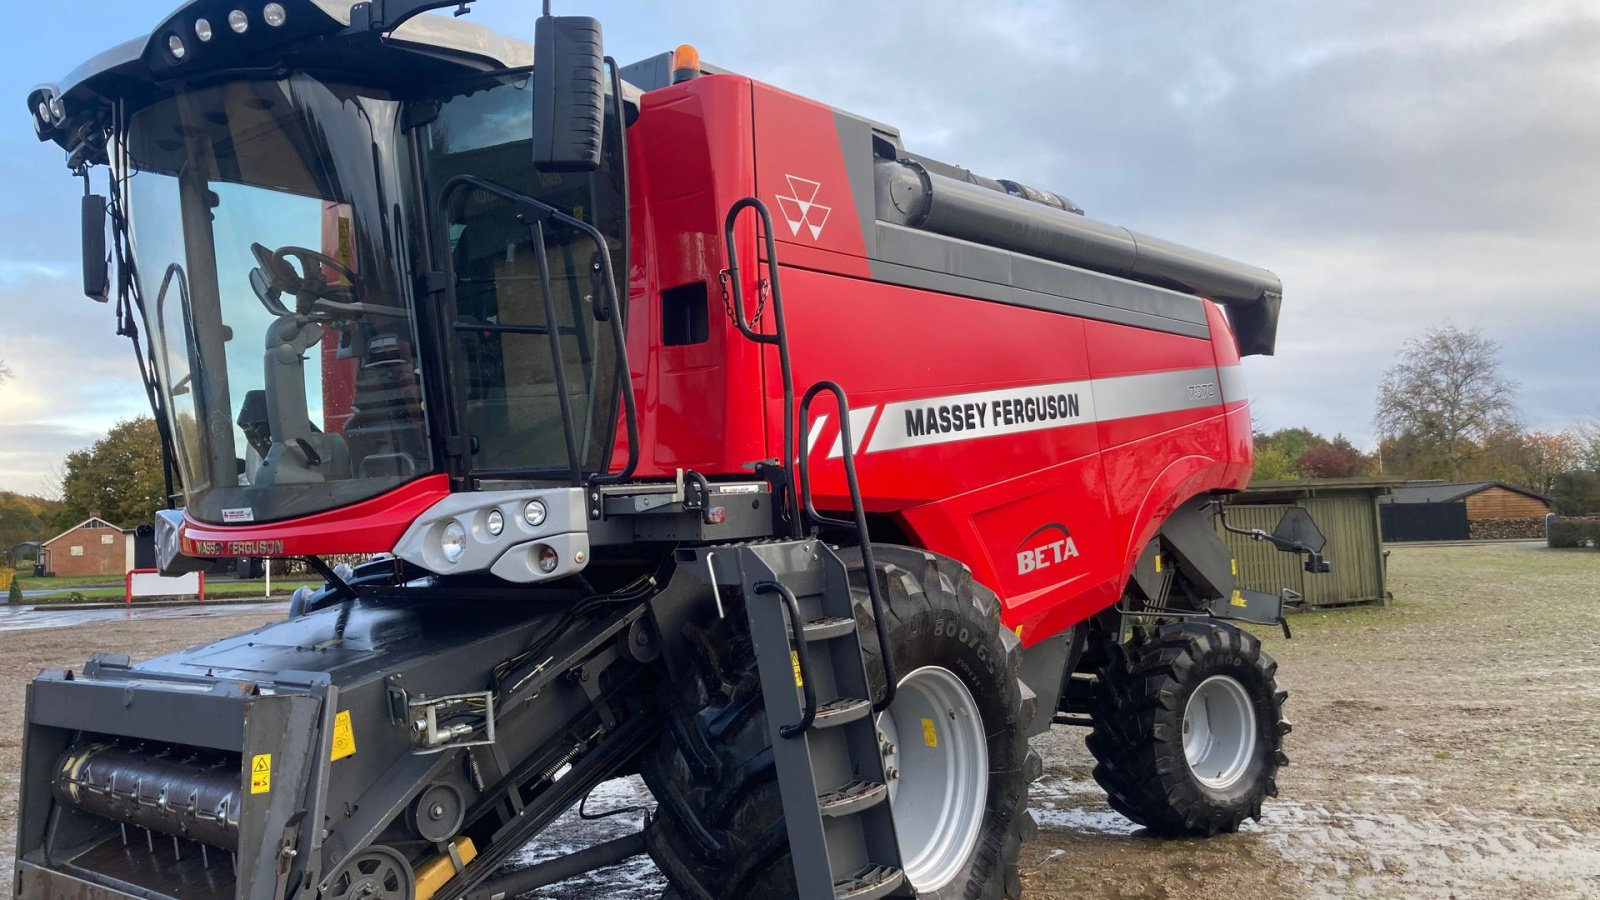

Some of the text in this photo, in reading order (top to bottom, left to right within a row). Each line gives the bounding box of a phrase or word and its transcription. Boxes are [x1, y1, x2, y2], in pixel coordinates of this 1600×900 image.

[904, 393, 1080, 437] MASSEY FERGUSON
[227, 540, 284, 555] FERGUSON
[1016, 536, 1079, 576] BETA
